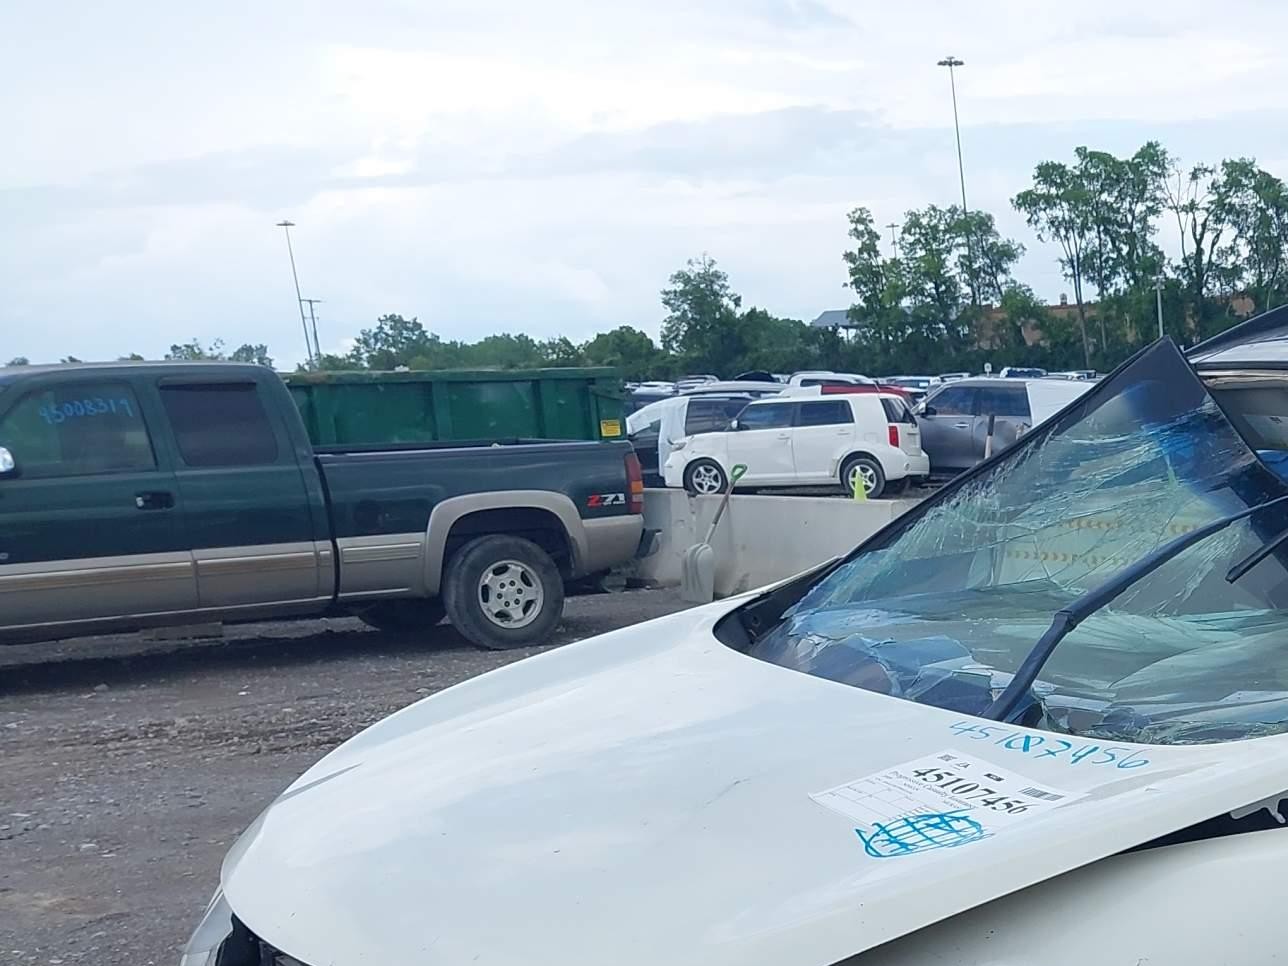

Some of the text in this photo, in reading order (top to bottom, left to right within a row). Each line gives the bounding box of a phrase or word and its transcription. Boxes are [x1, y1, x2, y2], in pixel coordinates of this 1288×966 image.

[587, 493, 626, 506] Z71
[949, 721, 1153, 769] 45107456
[912, 766, 1038, 815] 45107456
